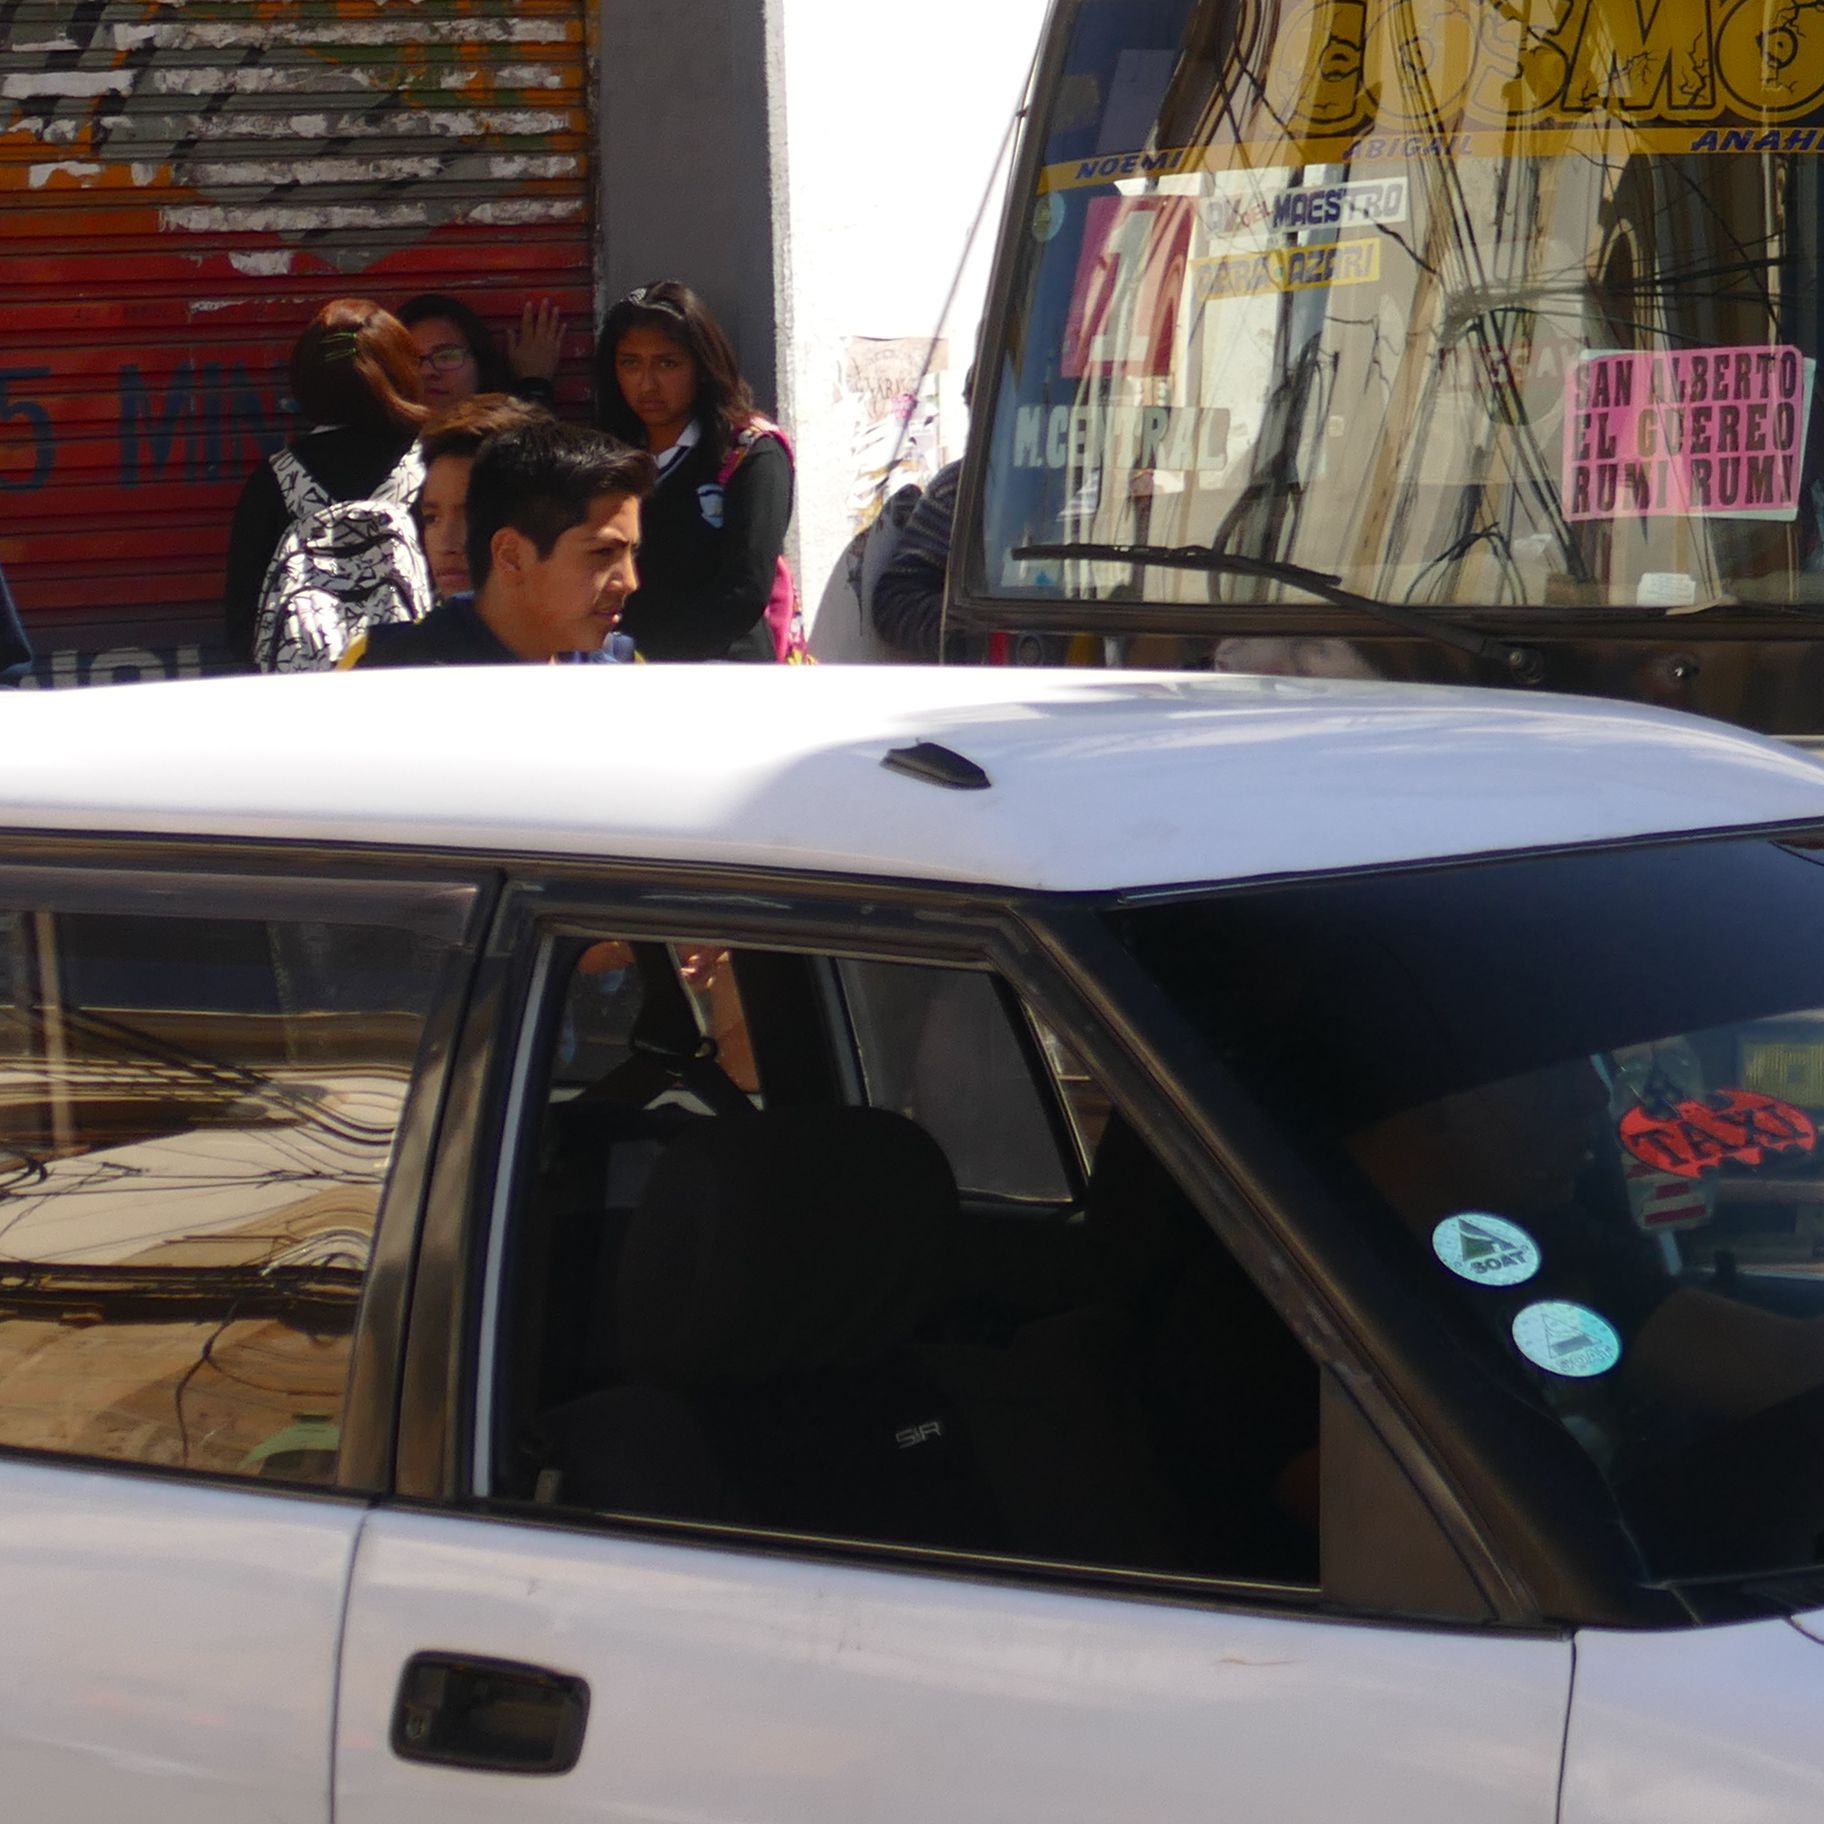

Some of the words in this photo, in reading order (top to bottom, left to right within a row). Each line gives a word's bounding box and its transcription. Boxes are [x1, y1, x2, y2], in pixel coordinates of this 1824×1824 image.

[1074, 150, 1184, 179] NOEMI
[1342, 133, 1474, 161] ABIGAIL
[1272, 183, 1405, 228] MAESTRO
[1574, 359, 1633, 409] SAN
[1650, 350, 1797, 405] ALBERTO
[1013, 406, 1228, 469] M.CENTRAL
[1574, 412, 1616, 461] EL
[1571, 460, 1669, 515] RUMI
[1630, 1097, 1811, 1170] TAXI
